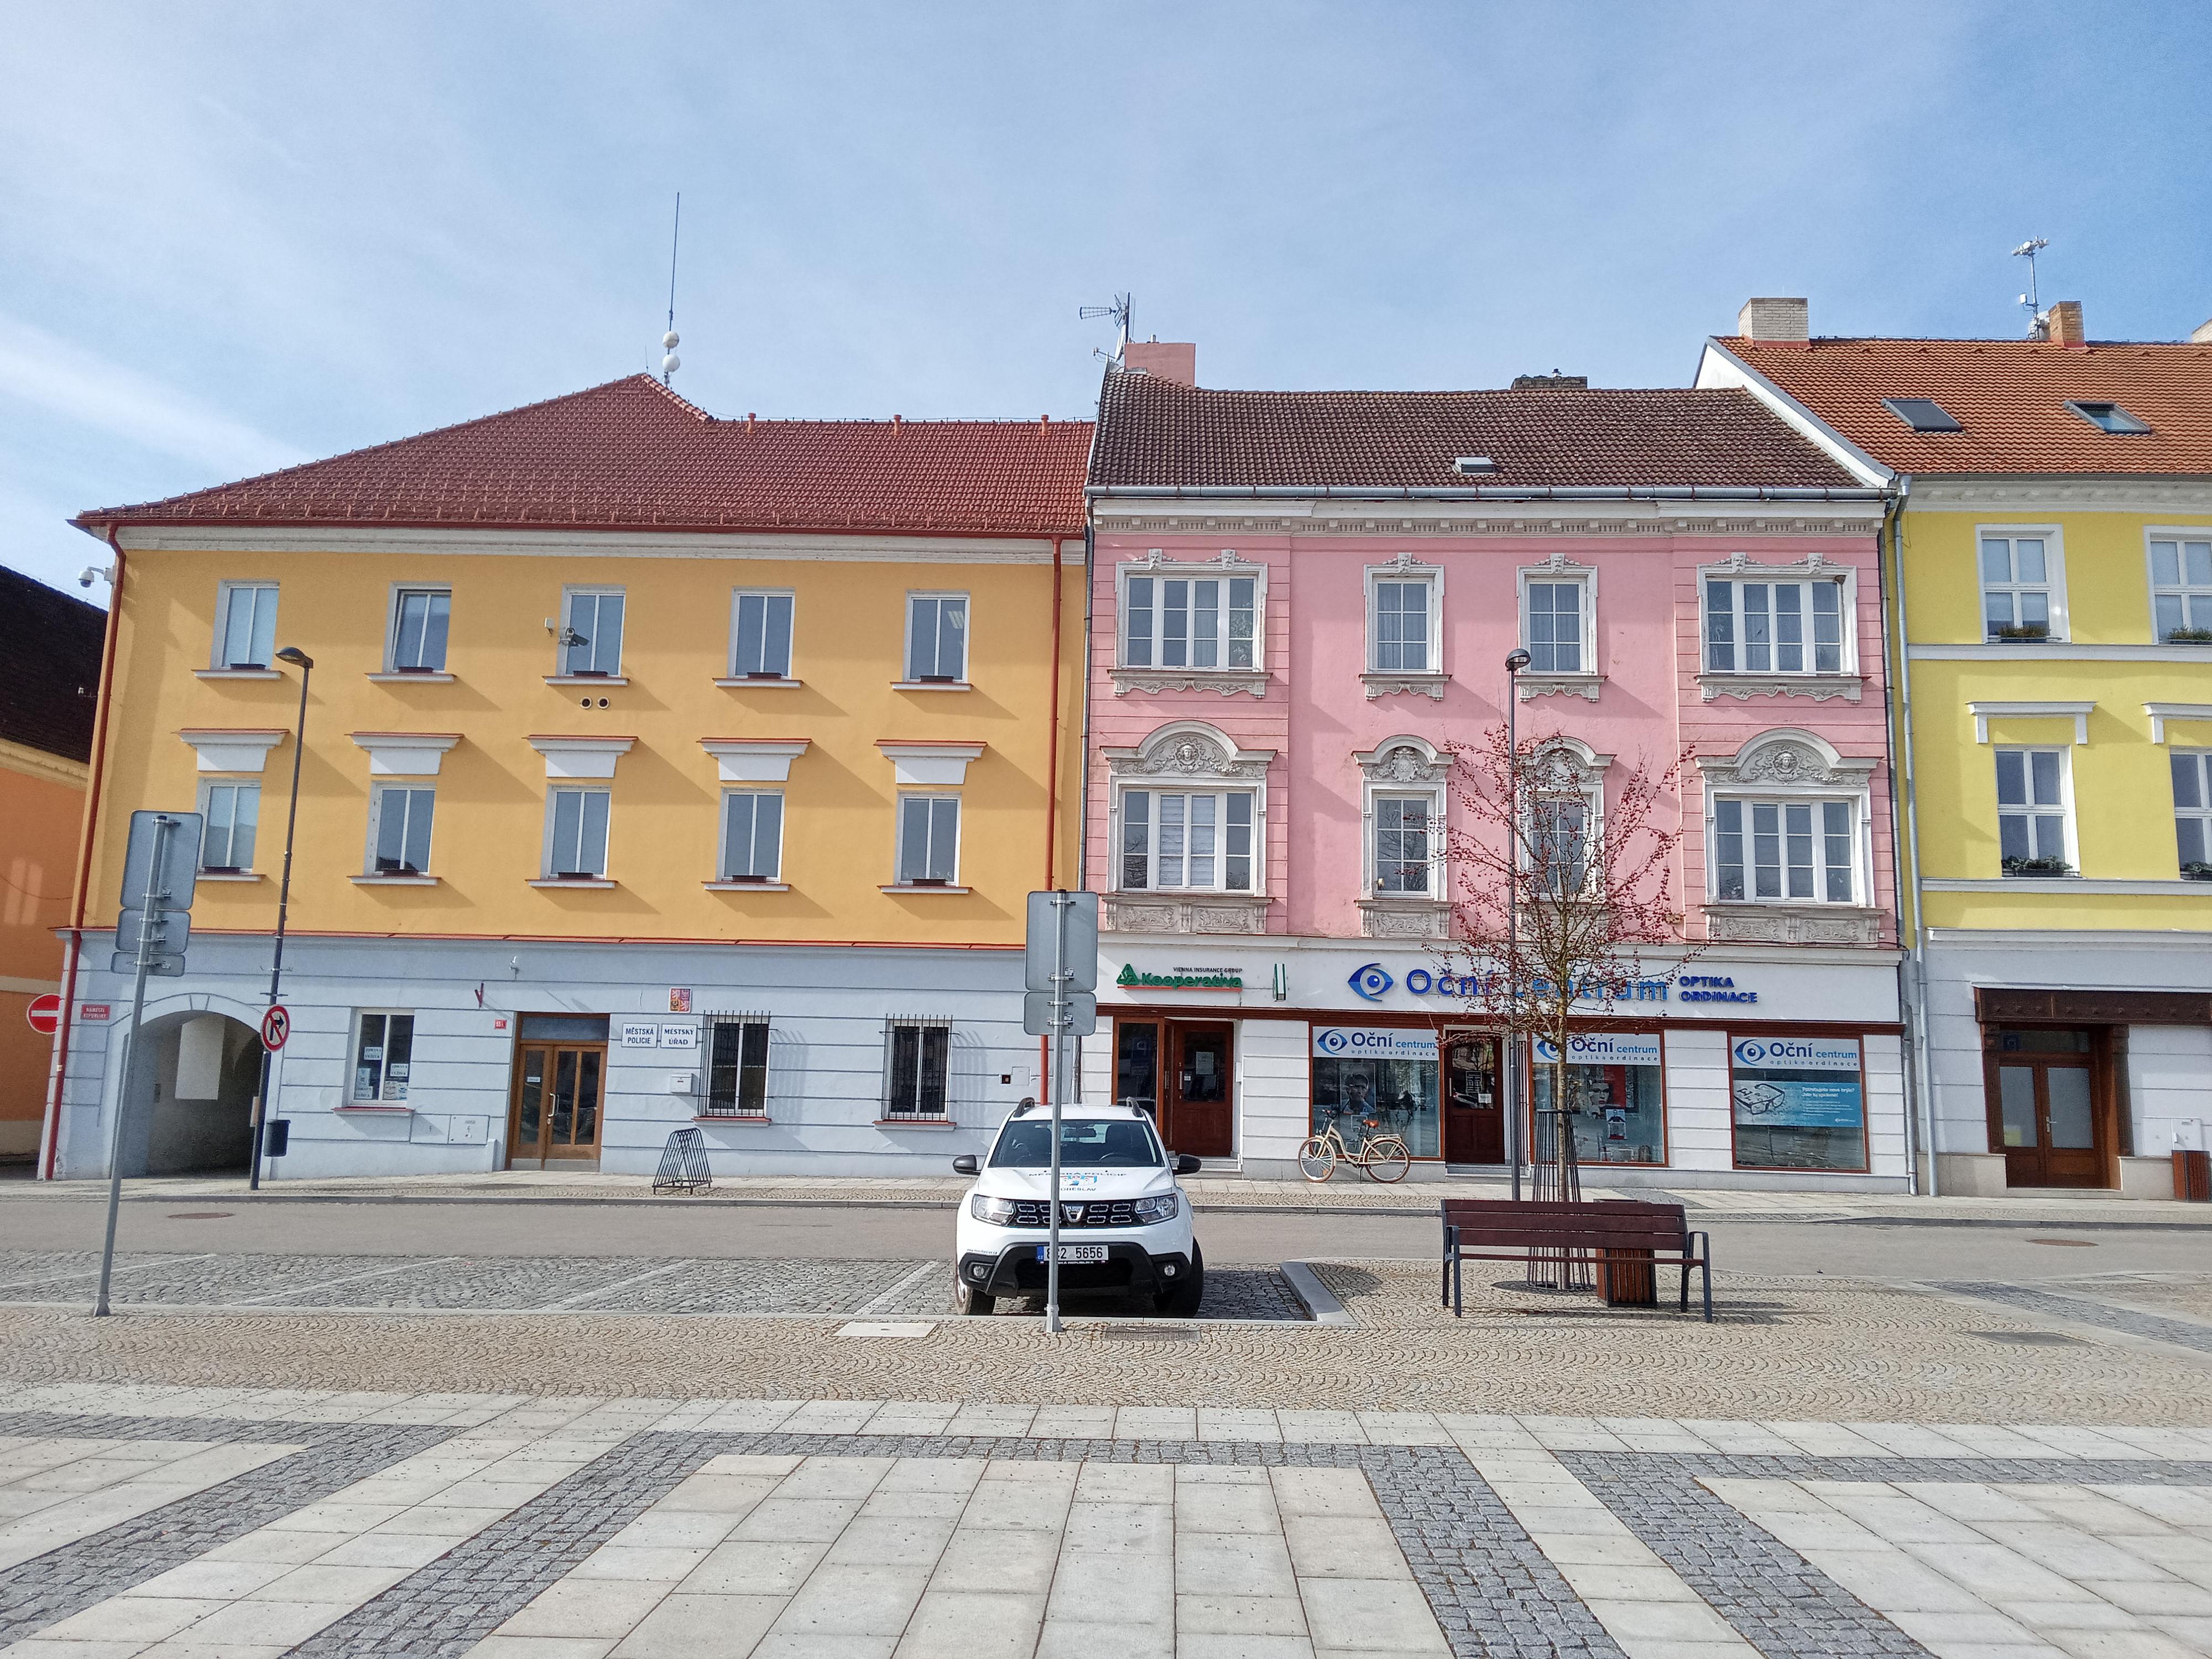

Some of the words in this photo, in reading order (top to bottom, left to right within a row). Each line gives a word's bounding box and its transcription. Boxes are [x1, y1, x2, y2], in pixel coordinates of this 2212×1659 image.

[1142, 973, 1243, 989] Kooperativa
[1679, 975, 1735, 988] OPTIKA
[1679, 990, 1758, 1003] ORDINACE
[625, 1027, 654, 1035] MĚSTSKÁ
[1351, 1032, 1394, 1047] Oční
[1395, 1040, 1436, 1048] centrum
[1572, 1037, 1615, 1052] Oční
[1616, 1045, 1657, 1053] centrum
[1770, 1042, 1813, 1058] Oční
[1816, 1051, 1857, 1059] centrum
[1076, 1246, 1103, 1259] 5656
